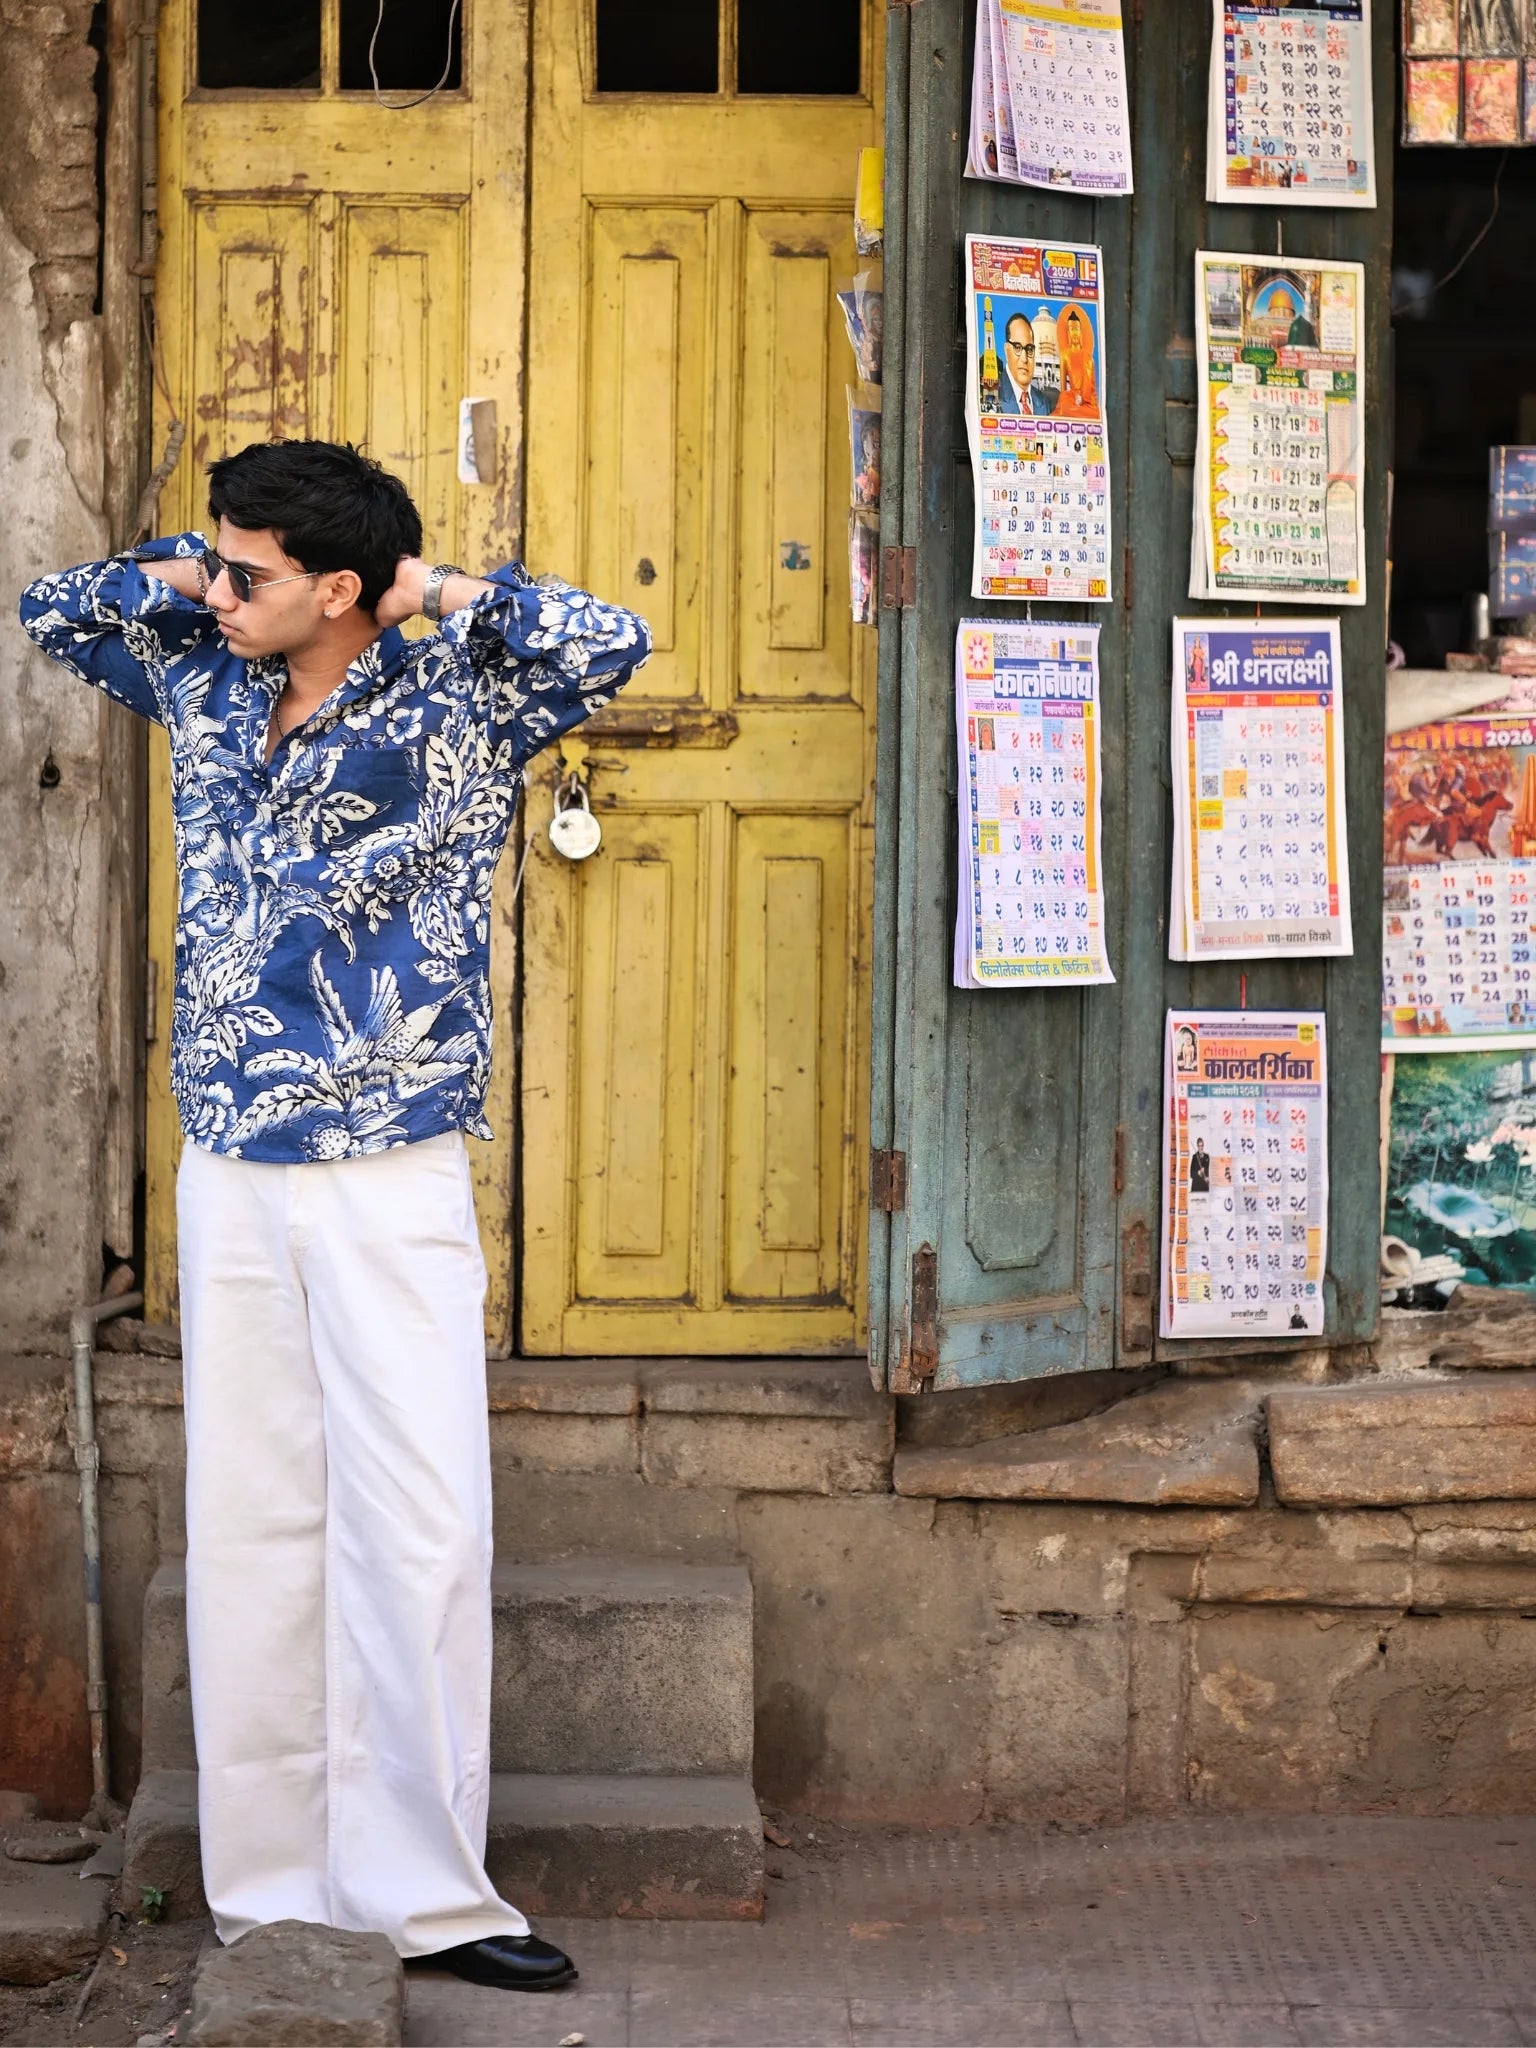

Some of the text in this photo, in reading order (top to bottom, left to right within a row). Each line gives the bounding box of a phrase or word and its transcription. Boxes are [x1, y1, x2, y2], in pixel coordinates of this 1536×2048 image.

[1052, 266, 1074, 278] 2026
[1266, 368, 1296, 376] JANUARY
[1267, 374, 1299, 386] 2026
[1253, 390, 1318, 405] 4 11 18 25
[1253, 417, 1319, 431] 5 12 19 26
[1066, 436, 1103, 448] 1 2 3
[1253, 444, 1320, 458] 6 13 20 27
[995, 462, 1104, 477] 4 5 6 7 8 9 10
[1253, 471, 1320, 486] 7 14 21 28
[993, 490, 1104, 505] 11 12 13 14 15 16 17
[1233, 496, 1319, 512] 1 8 15 22 29
[991, 520, 1104, 534] 18 19 20 21 22 23 24
[1233, 523, 1320, 539] 2 9 16 23 30
[990, 548, 1104, 562] 25 26 27 28 29 30 31
[1235, 550, 1321, 566] 3 10 17 24 31
[1211, 650, 1329, 685] श्री धनलक्ष्मी
[994, 662, 1093, 699] कालनिर्णय
[1486, 729, 1533, 747] 2026
[1412, 894, 1528, 909] 5 12 19 26
[1414, 912, 1527, 928] 6 13 20 27
[1386, 950, 1529, 968] 1 8 15 22 29
[981, 961, 1024, 977] फिनोलेक्स
[1386, 970, 1530, 986] 2 9 16 23 30
[1204, 1052, 1314, 1079] कालदर्शिका
